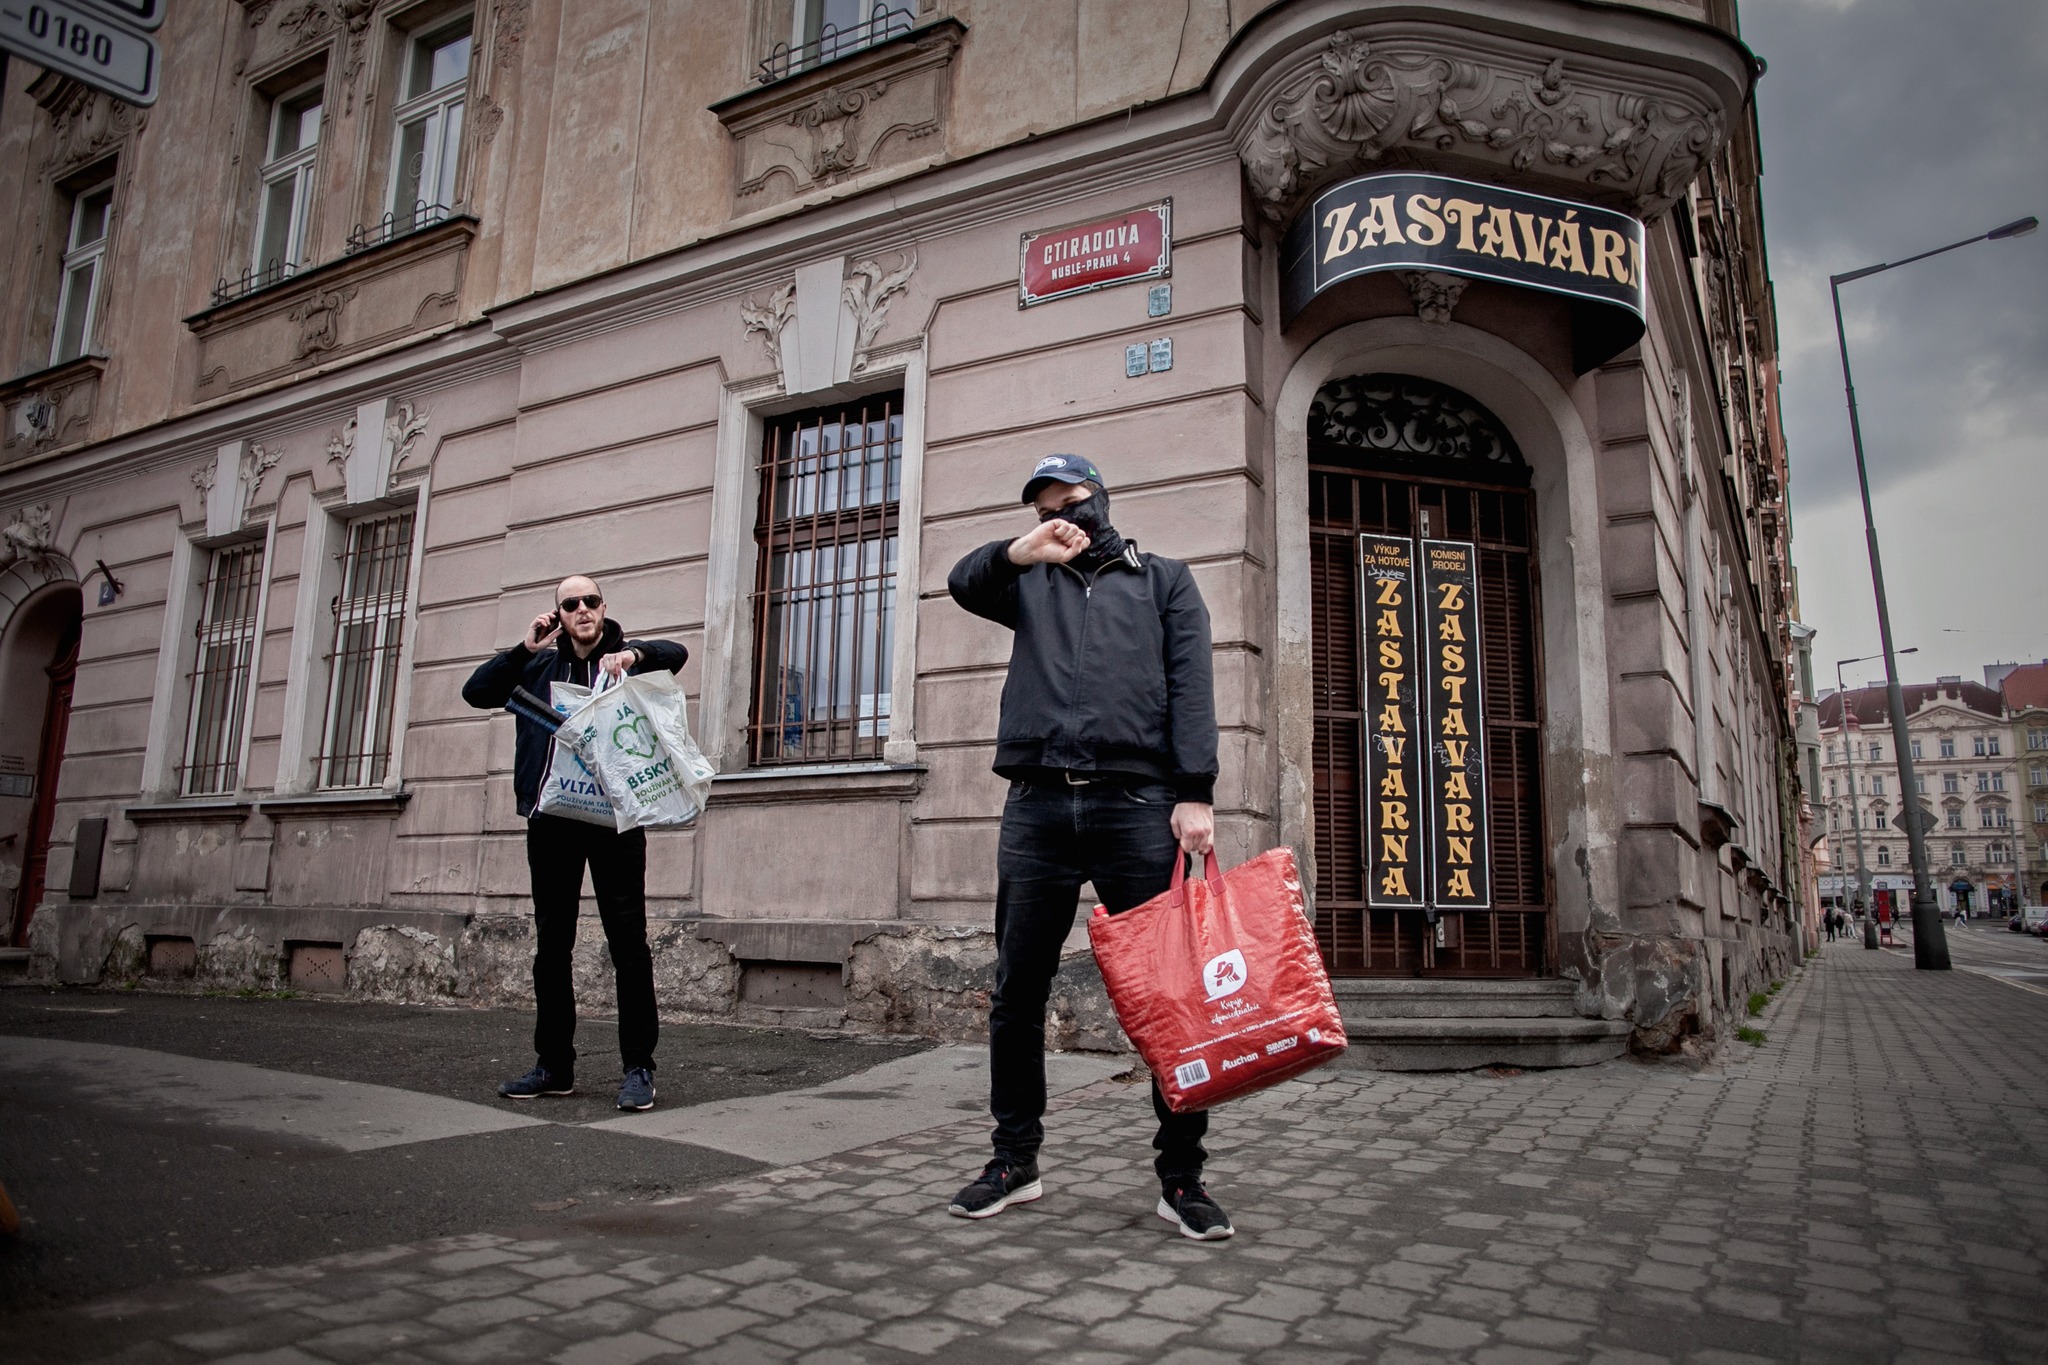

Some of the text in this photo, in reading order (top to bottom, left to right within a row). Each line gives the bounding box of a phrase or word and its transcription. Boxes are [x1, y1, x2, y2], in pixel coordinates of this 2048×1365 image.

[1044, 224, 1139, 265] CTIRADOVA
[1123, 251, 1131, 263] 4
[1374, 543, 1400, 555] VÝKUP
[1430, 550, 1466, 561] KOMISNÍ
[1365, 555, 1410, 567] ZA HOTOVÉ
[1432, 560, 1466, 571] PRODEJ
[102, 586, 109, 599] 2
[616, 702, 635, 721] JÁ
[1376, 578, 1410, 896] ZASTAVARNA
[1438, 583, 1475, 897] ZASTAVARNA
[639, 790, 667, 808] ZNOVU
[591, 807, 615, 816] ZNOV
[1222, 1052, 1259, 1071] Auchan
[1265, 1035, 1298, 1052] SIMPLY
